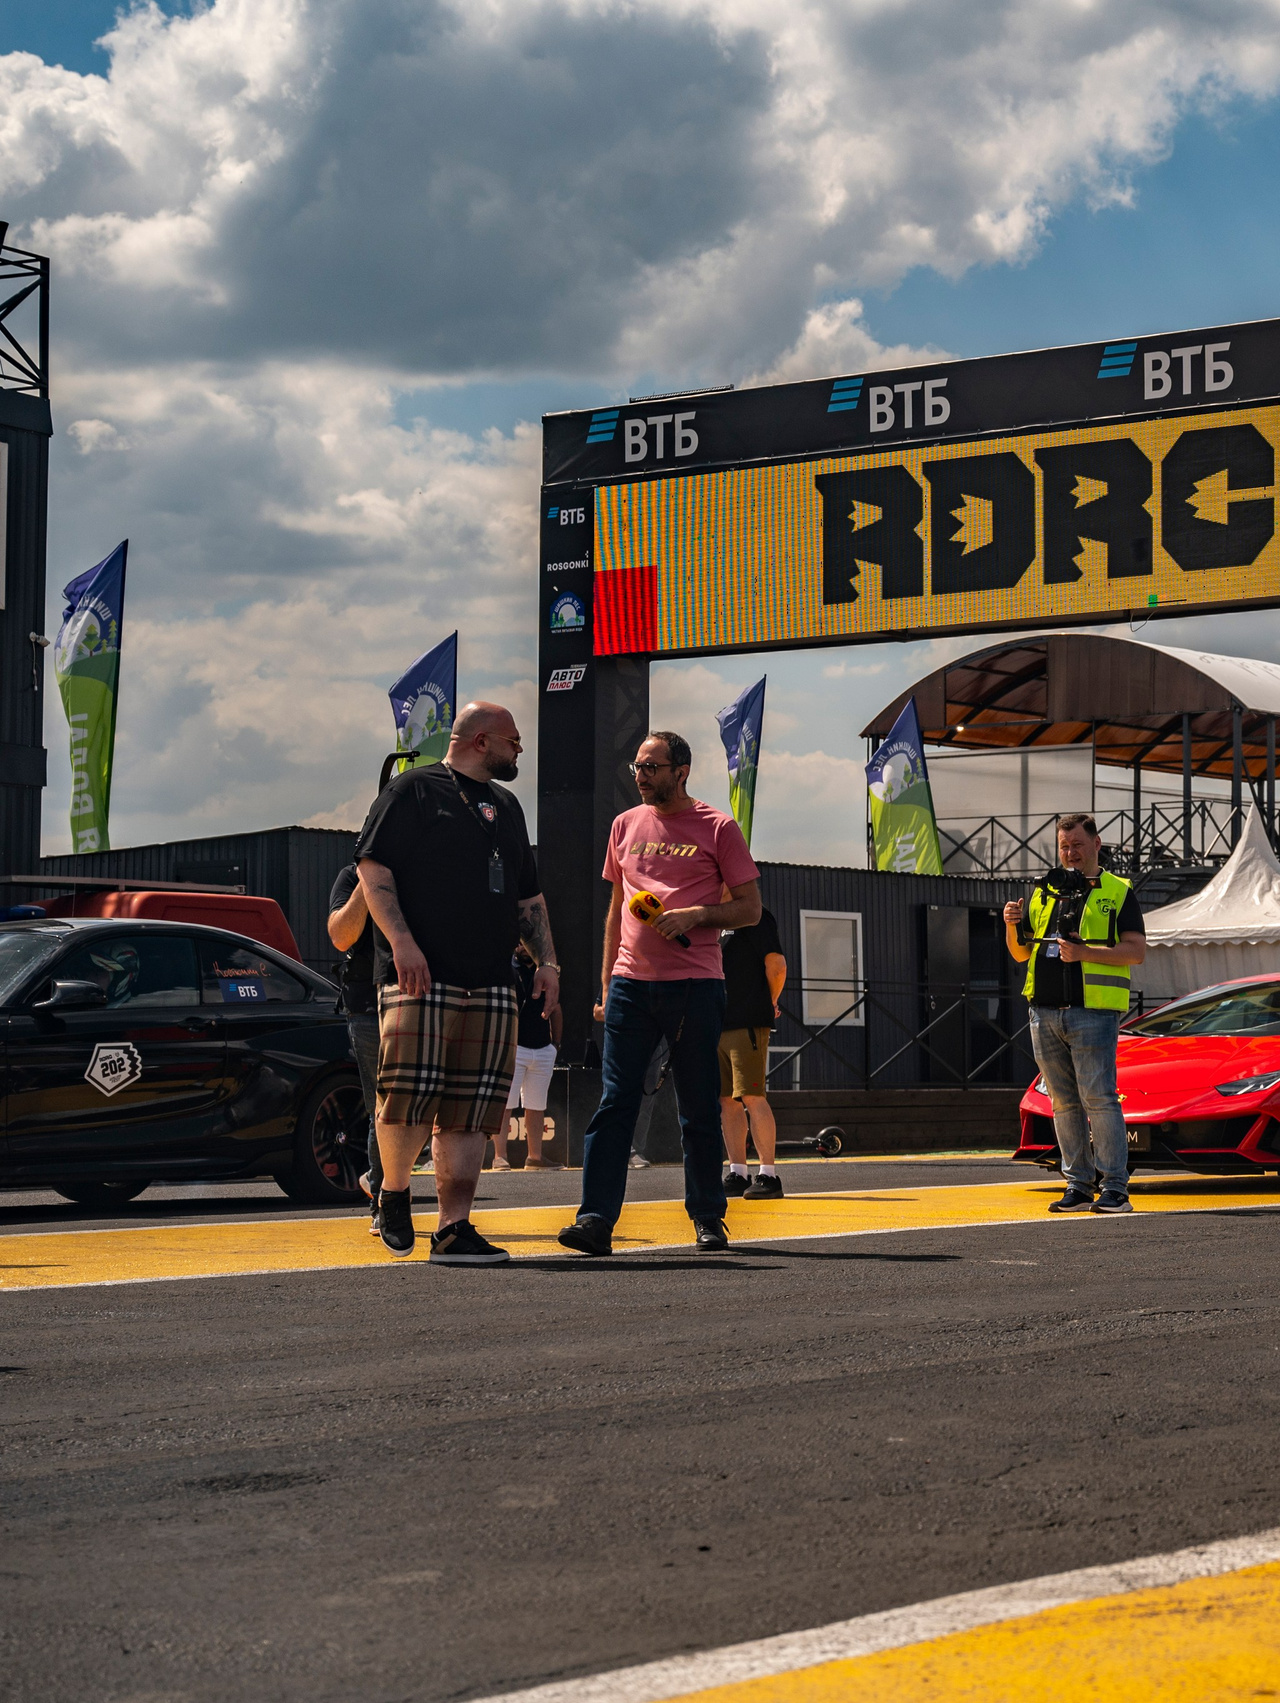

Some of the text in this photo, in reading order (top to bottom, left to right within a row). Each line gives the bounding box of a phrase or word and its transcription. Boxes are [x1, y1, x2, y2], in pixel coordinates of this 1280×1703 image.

[1143, 341, 1235, 400] ВТБ
[868, 377, 951, 434] ВТБ
[623, 410, 699, 463] ВТБ
[560, 507, 586, 526] ВТБ
[815, 423, 1276, 605] RDRC
[546, 559, 589, 572] ROSGONKI
[548, 681, 572, 690] ПЛЮС
[551, 669, 583, 682] АВТО
[237, 985, 258, 997] ВТБ
[101, 1056, 126, 1078] 202
